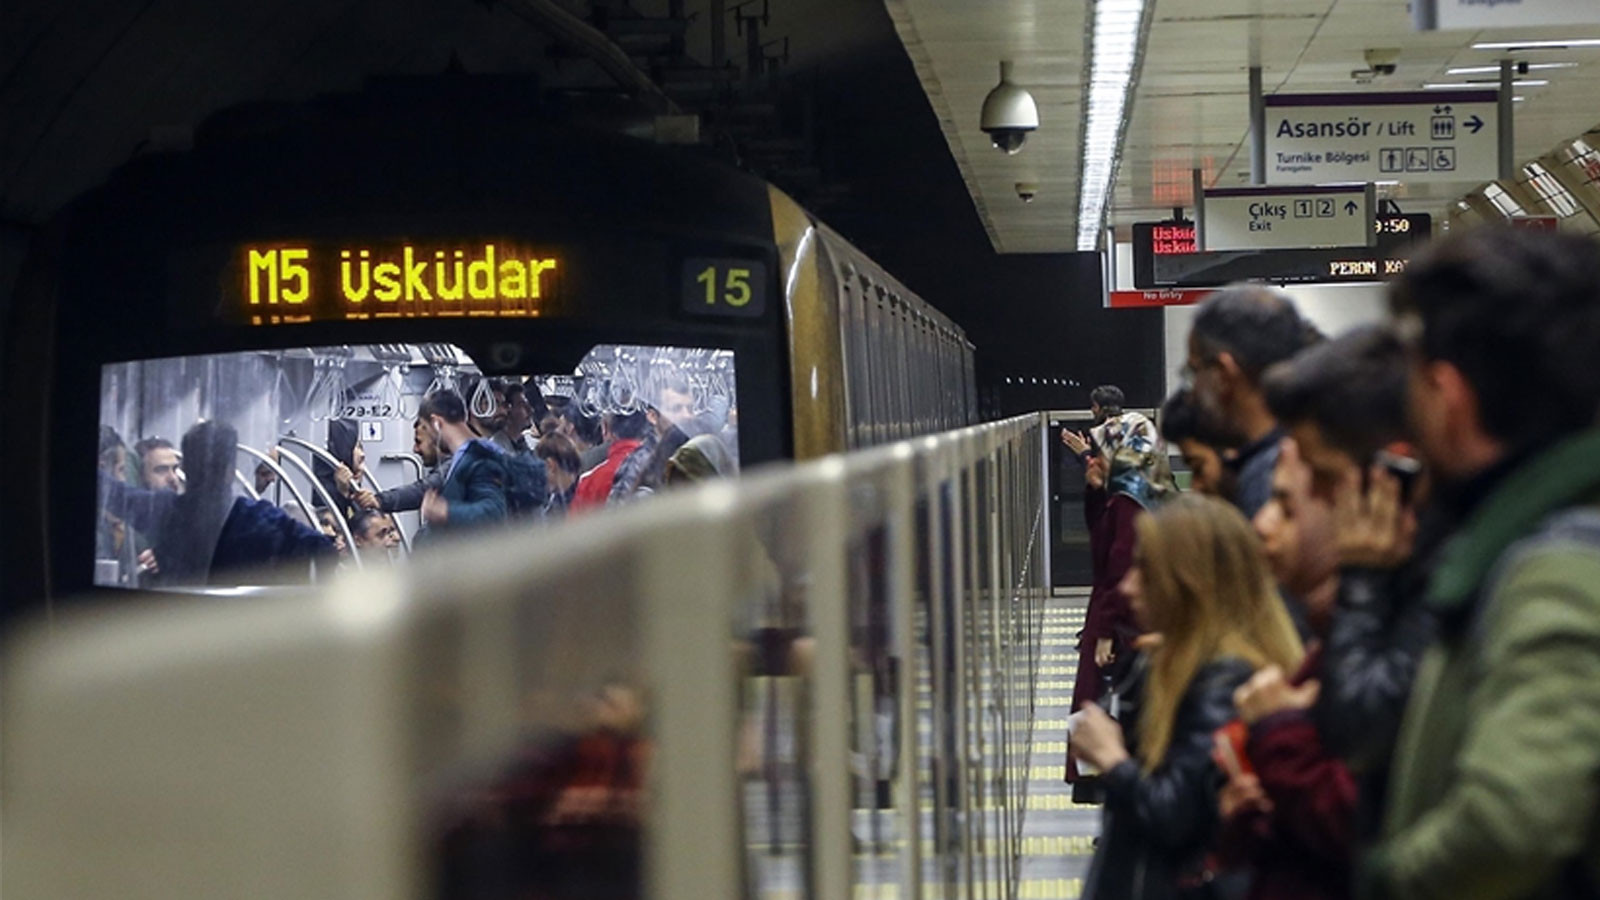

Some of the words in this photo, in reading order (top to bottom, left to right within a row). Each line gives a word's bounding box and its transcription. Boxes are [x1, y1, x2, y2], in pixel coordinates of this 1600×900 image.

[1276, 117, 1371, 138] Asansör
[1388, 121, 1415, 136] Lift
[1276, 152, 1322, 163] Turnike
[1325, 151, 1370, 165] Bölgesi
[1248, 202, 1287, 220] Çıkış
[1249, 221, 1272, 231] Exit
[249, 248, 310, 304] M5
[340, 245, 556, 302] Üsküdar
[1329, 261, 1377, 275] PERON
[697, 266, 752, 307] 15
